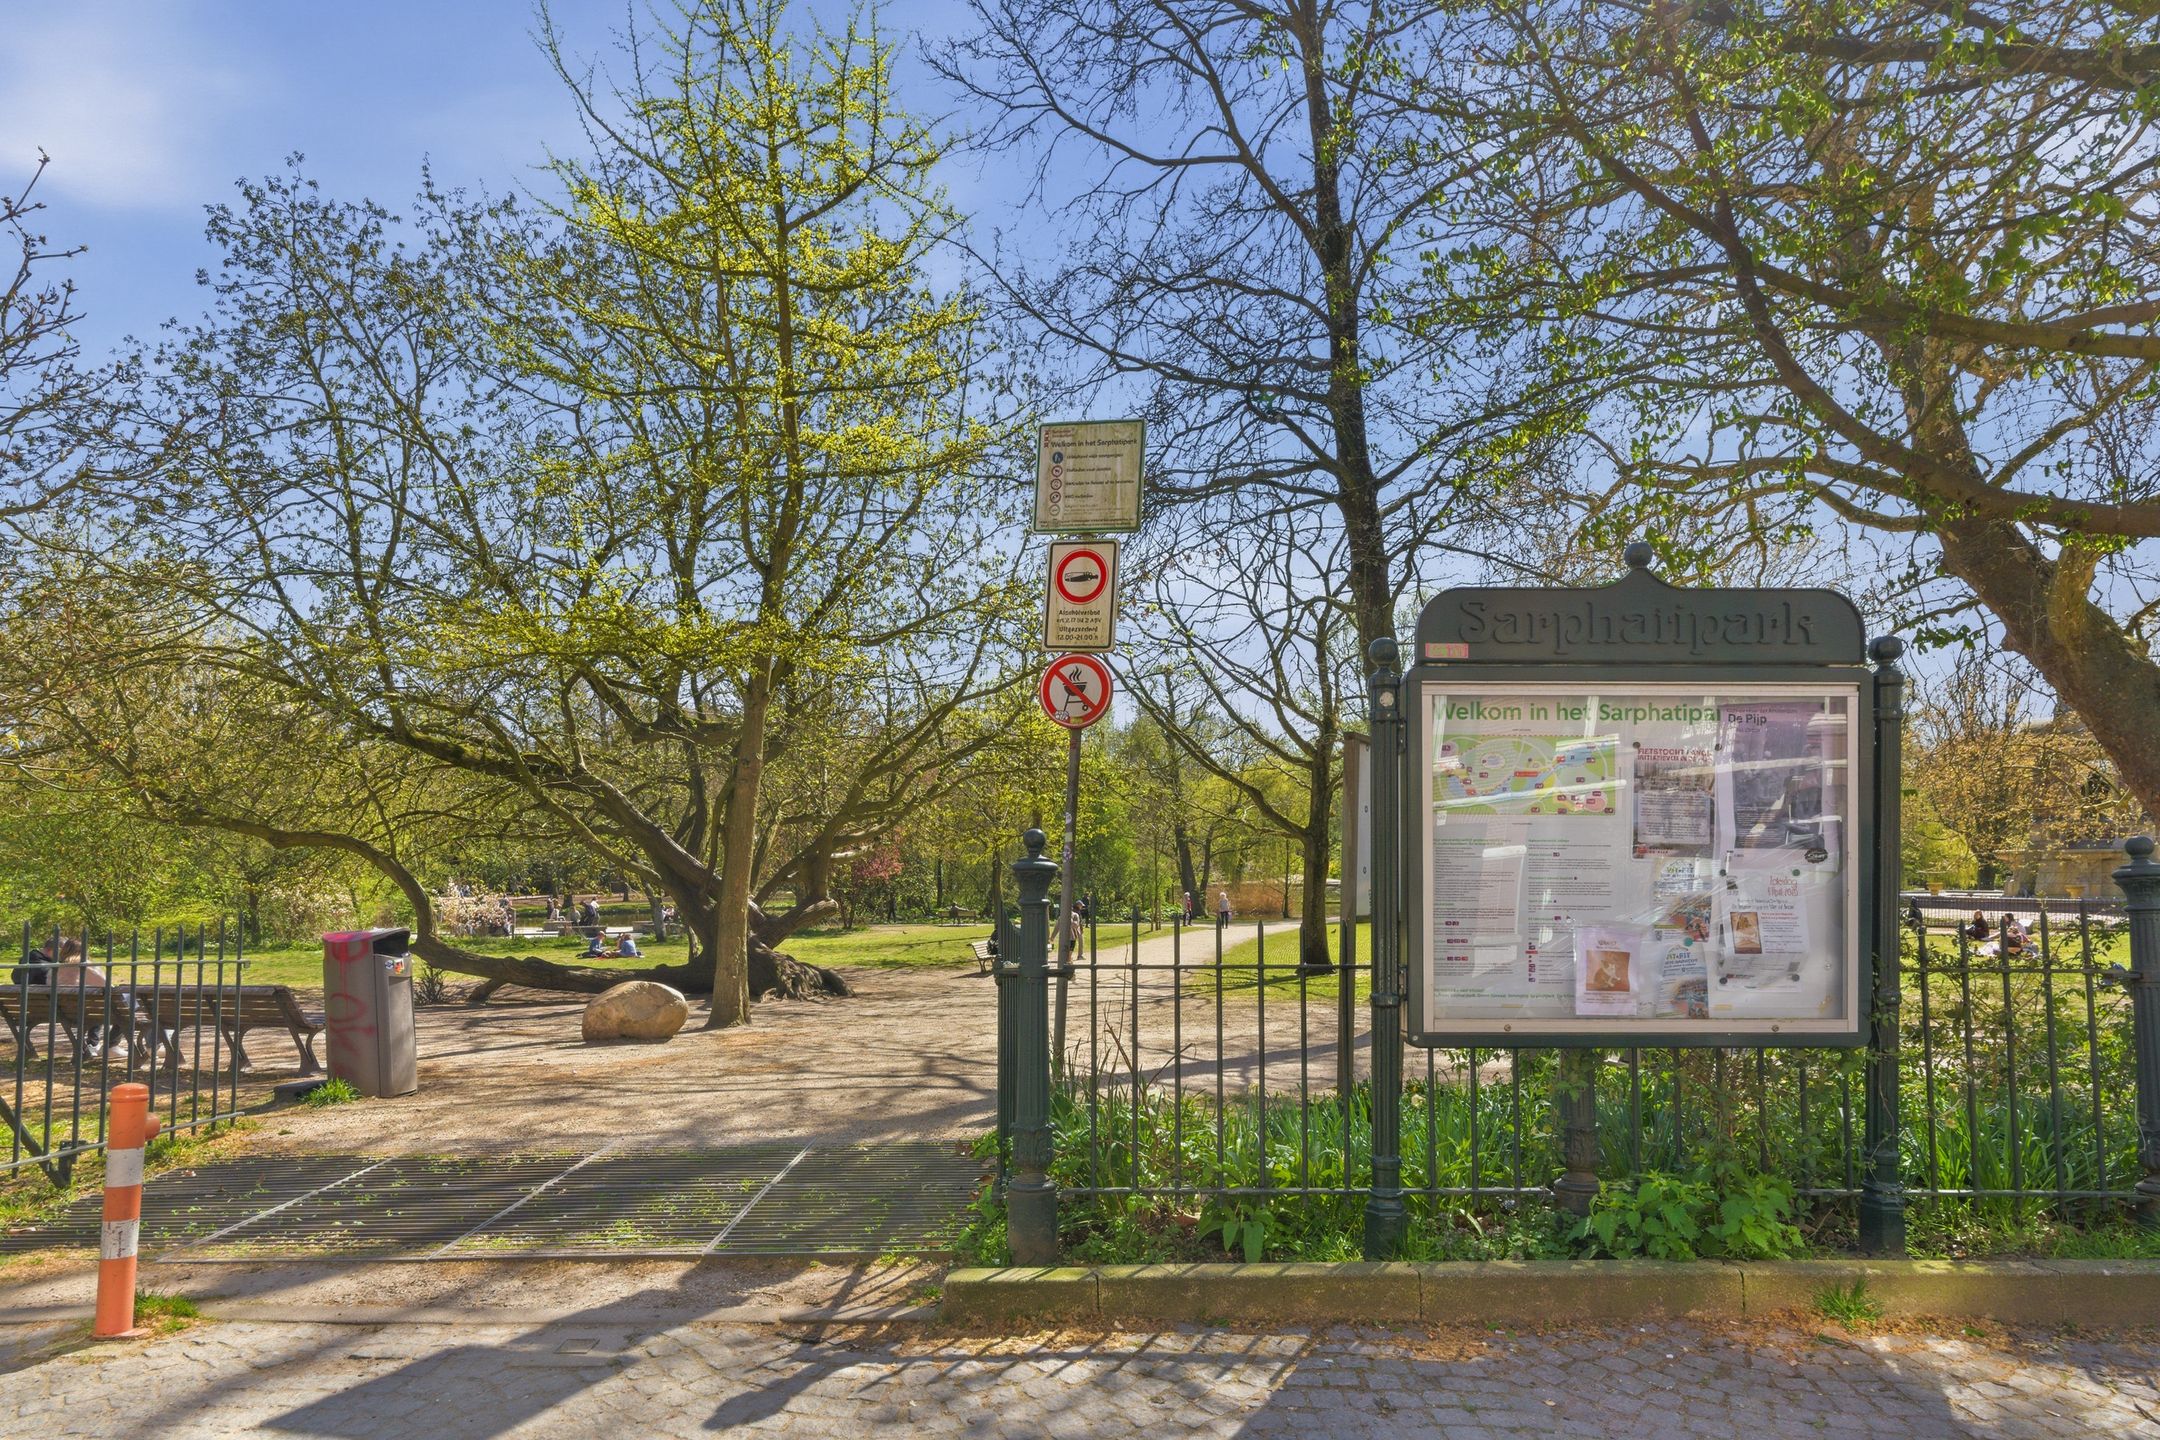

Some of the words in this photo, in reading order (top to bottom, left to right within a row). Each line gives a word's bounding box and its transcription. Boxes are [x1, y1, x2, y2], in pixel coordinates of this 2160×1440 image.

[1458, 601, 1819, 655] Sarphatipark
[1435, 702, 1522, 721] Welkom
[1530, 702, 1549, 720] in
[1556, 702, 1592, 720] het
[1599, 702, 1721, 725] Sarphatipar
[1728, 713, 1743, 723] De
[1745, 713, 1767, 726] Pijp
